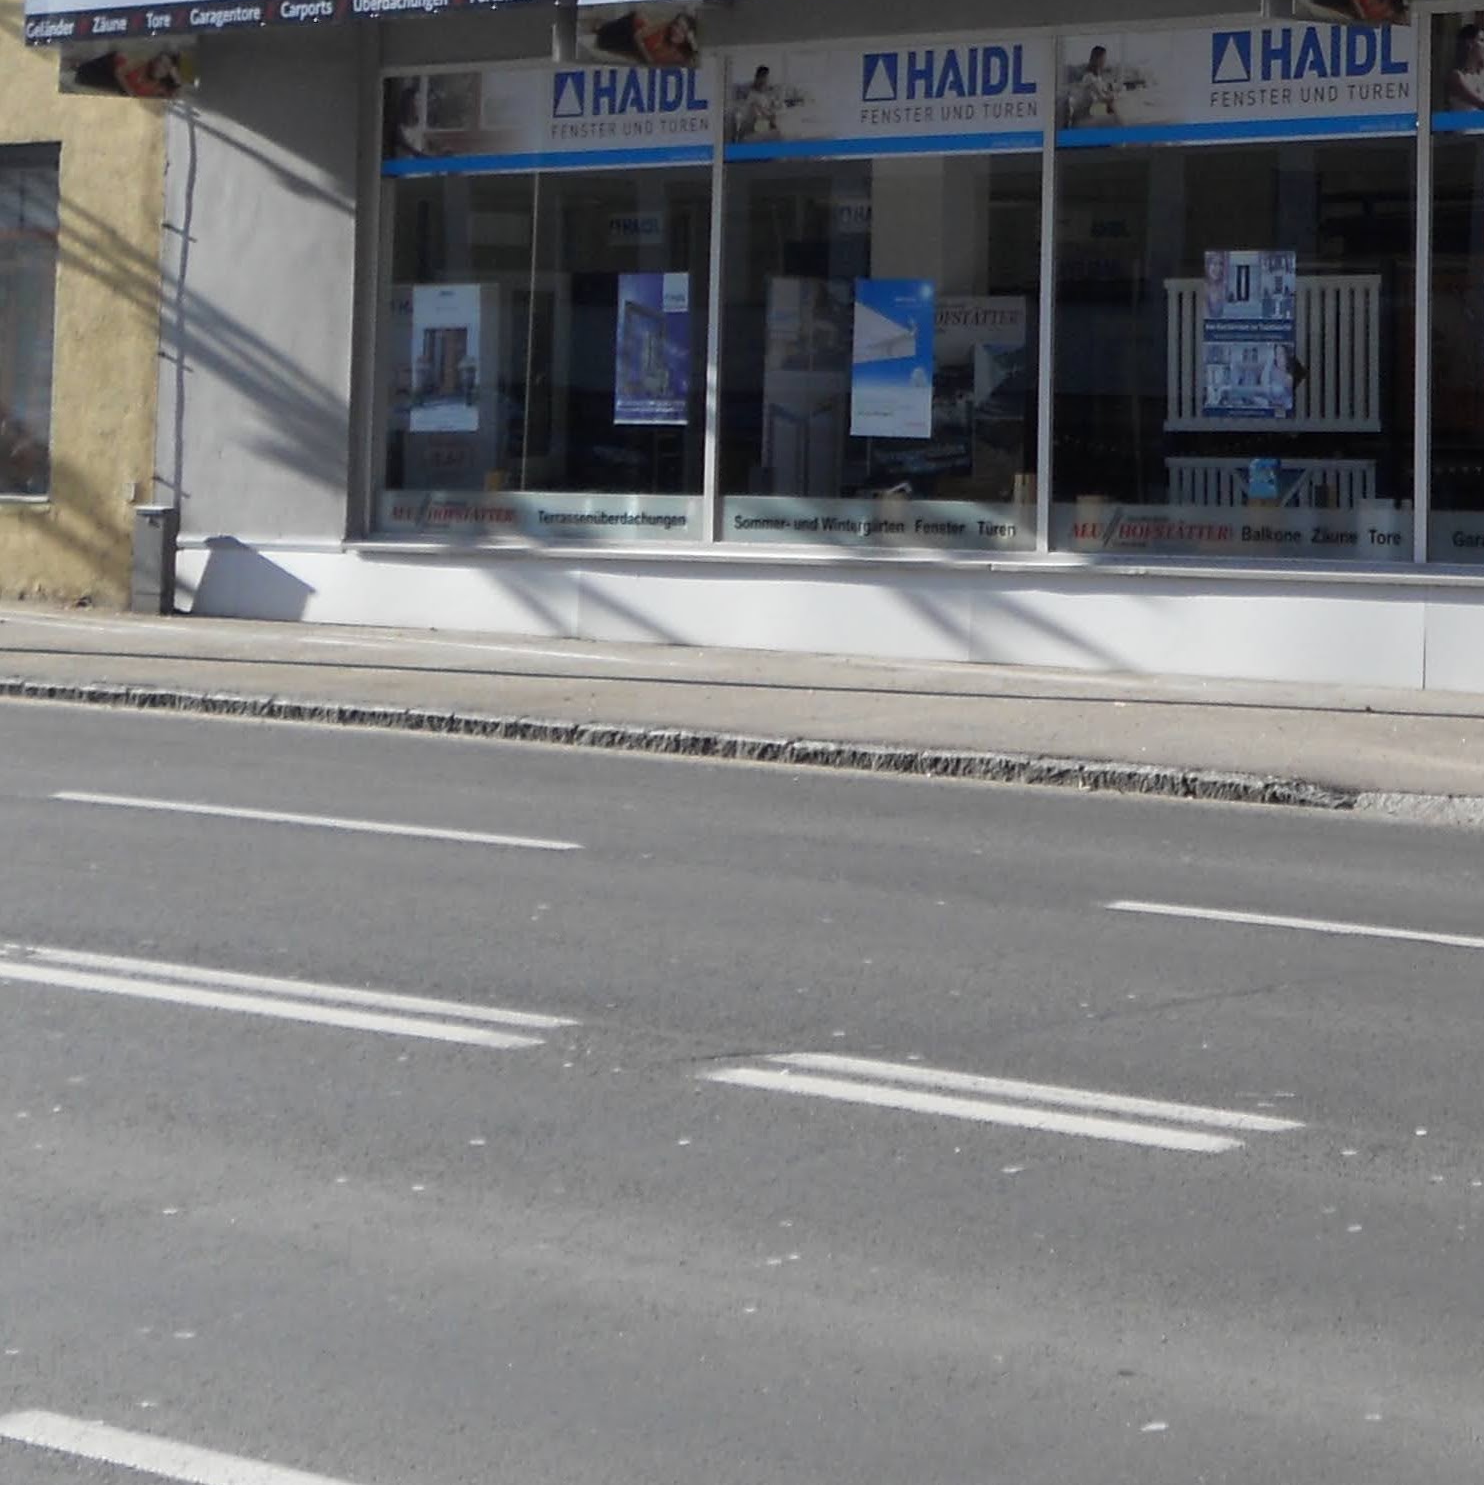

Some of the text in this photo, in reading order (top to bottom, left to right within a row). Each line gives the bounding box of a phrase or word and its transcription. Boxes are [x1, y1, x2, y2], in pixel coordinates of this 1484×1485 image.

[27, 22, 74, 39] Geländer
[92, 16, 127, 33] Zäune
[146, 13, 171, 29] Tore
[190, 6, 261, 27] Garagentore
[280, 1, 333, 21] Carports
[1261, 25, 1409, 81] HAIDL
[905, 44, 1037, 100] HAIDL
[592, 67, 708, 116] HAIDL
[1209, 88, 1291, 107] FENSTER
[1300, 85, 1338, 103] UND
[861, 106, 933, 125] FENSTER
[941, 104, 976, 122] UND
[551, 121, 616, 140] FENSTER
[624, 120, 653, 137] UND
[538, 509, 687, 530] Terrassenüberdachungen
[734, 516, 790, 531] Sommer-
[794, 517, 818, 532] und
[915, 518, 965, 534] Fenster
[978, 520, 1017, 537] Türen
[1242, 524, 1302, 543] Balkone
[1369, 528, 1402, 546] Tore
